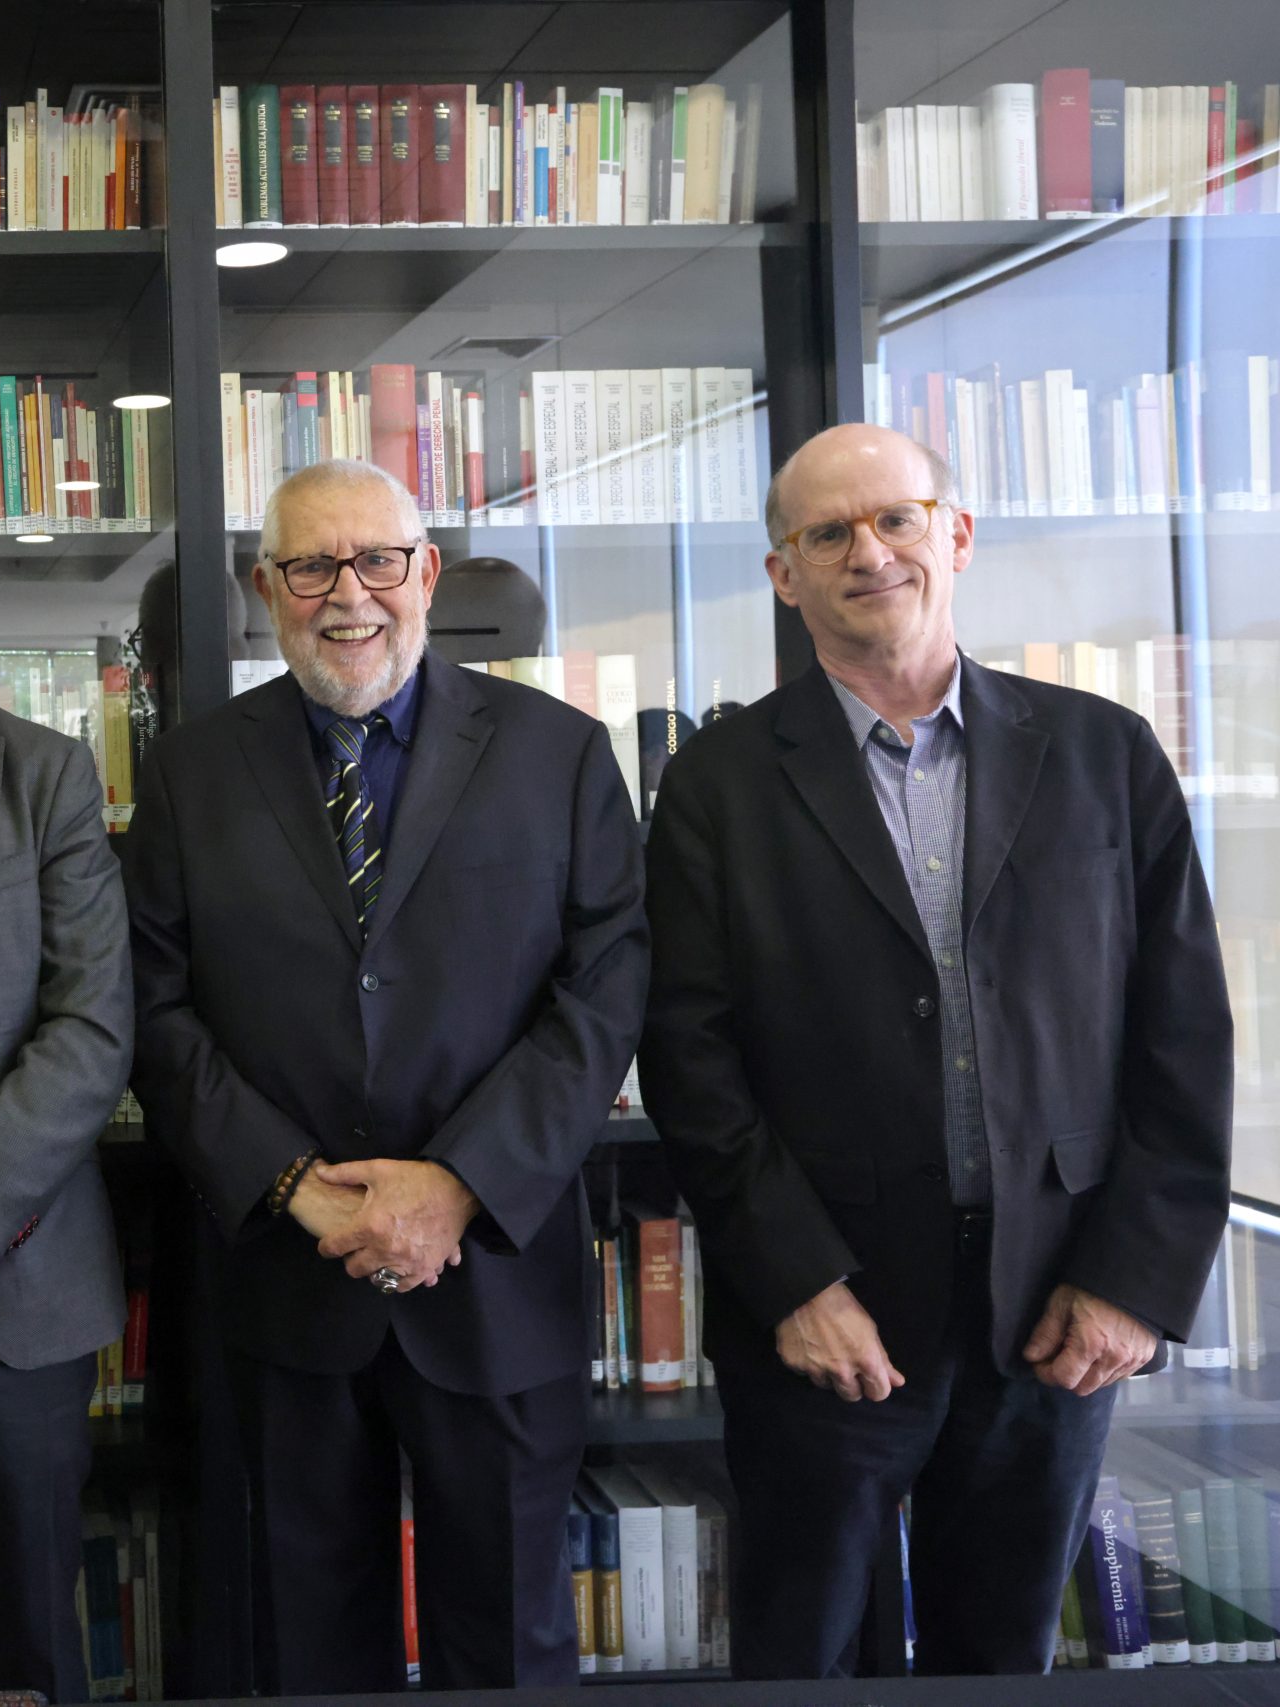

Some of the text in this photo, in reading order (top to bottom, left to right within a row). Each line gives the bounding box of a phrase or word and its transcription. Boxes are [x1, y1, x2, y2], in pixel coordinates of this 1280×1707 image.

[257, 104, 269, 218] PROBLEMAS ACTUALES DE LA JUSTICIA
[543, 398, 556, 430] ESPECIAL
[574, 400, 586, 430] ESPECIAL
[607, 401, 620, 430] ESPECIAL
[640, 401, 653, 431] ESPECIAL
[670, 399, 683, 429] ESPECIAL
[432, 398, 445, 511] FUNDAMENTOS DE DERECHO PENAL
[544, 431, 556, 452] PARTE
[575, 431, 587, 452] PARTE
[608, 431, 621, 451] PARTE
[713, 679, 721, 710] PENAL
[666, 677, 678, 755] CÓDIGO PENAL
[1100, 1509, 1127, 1612] Schizophrenia
